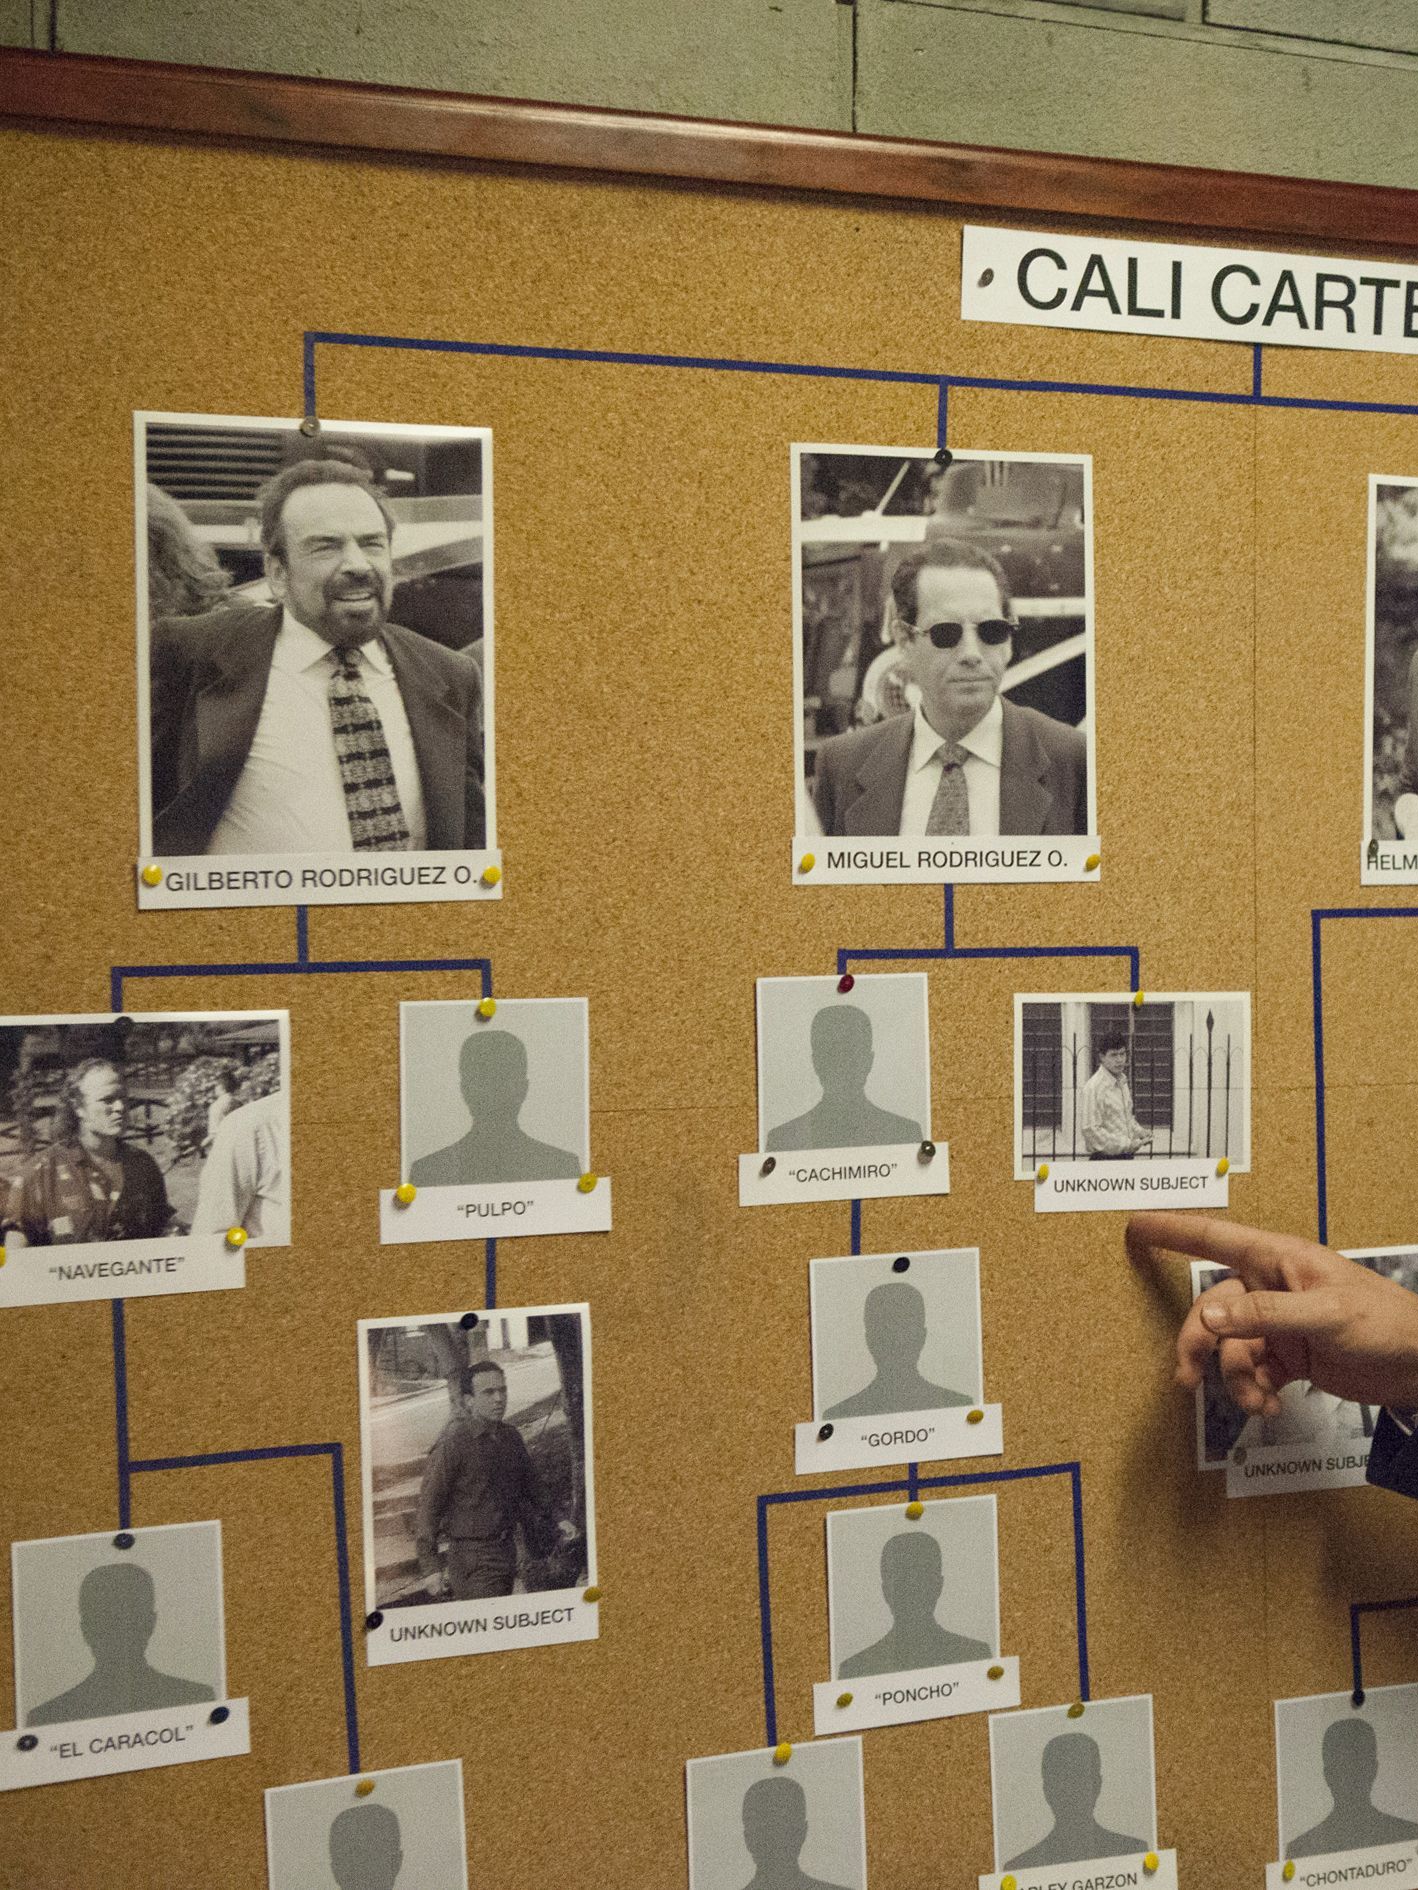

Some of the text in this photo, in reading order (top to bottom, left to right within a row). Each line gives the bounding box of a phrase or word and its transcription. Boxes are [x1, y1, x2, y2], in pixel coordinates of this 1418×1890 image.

[1016, 247, 1182, 320] CALI
[827, 849, 1068, 869] MIGUEL RODRIGUEZ O.
[165, 865, 478, 892] GILBERTO RODRIGUEZ O.
[788, 1163, 898, 1183] “CACHIMIRO”
[1053, 1176, 1210, 1193] UNKNOWN SUBJECT
[457, 1200, 534, 1218] “PULPO”
[49, 1256, 186, 1281] “NAVEGANTE”
[861, 1427, 936, 1447] “GORDO”
[1244, 1454, 1372, 1479] UNKNOWN SUBJE
[390, 1607, 575, 1643] UNKNOWN SUBJECT
[874, 1682, 960, 1706] “PONCHO”
[50, 1725, 195, 1759] “EL CARACOL”
[1071, 1872, 1138, 1890] GARZON
[1299, 1858, 1413, 1888] “CHONTADURO”
